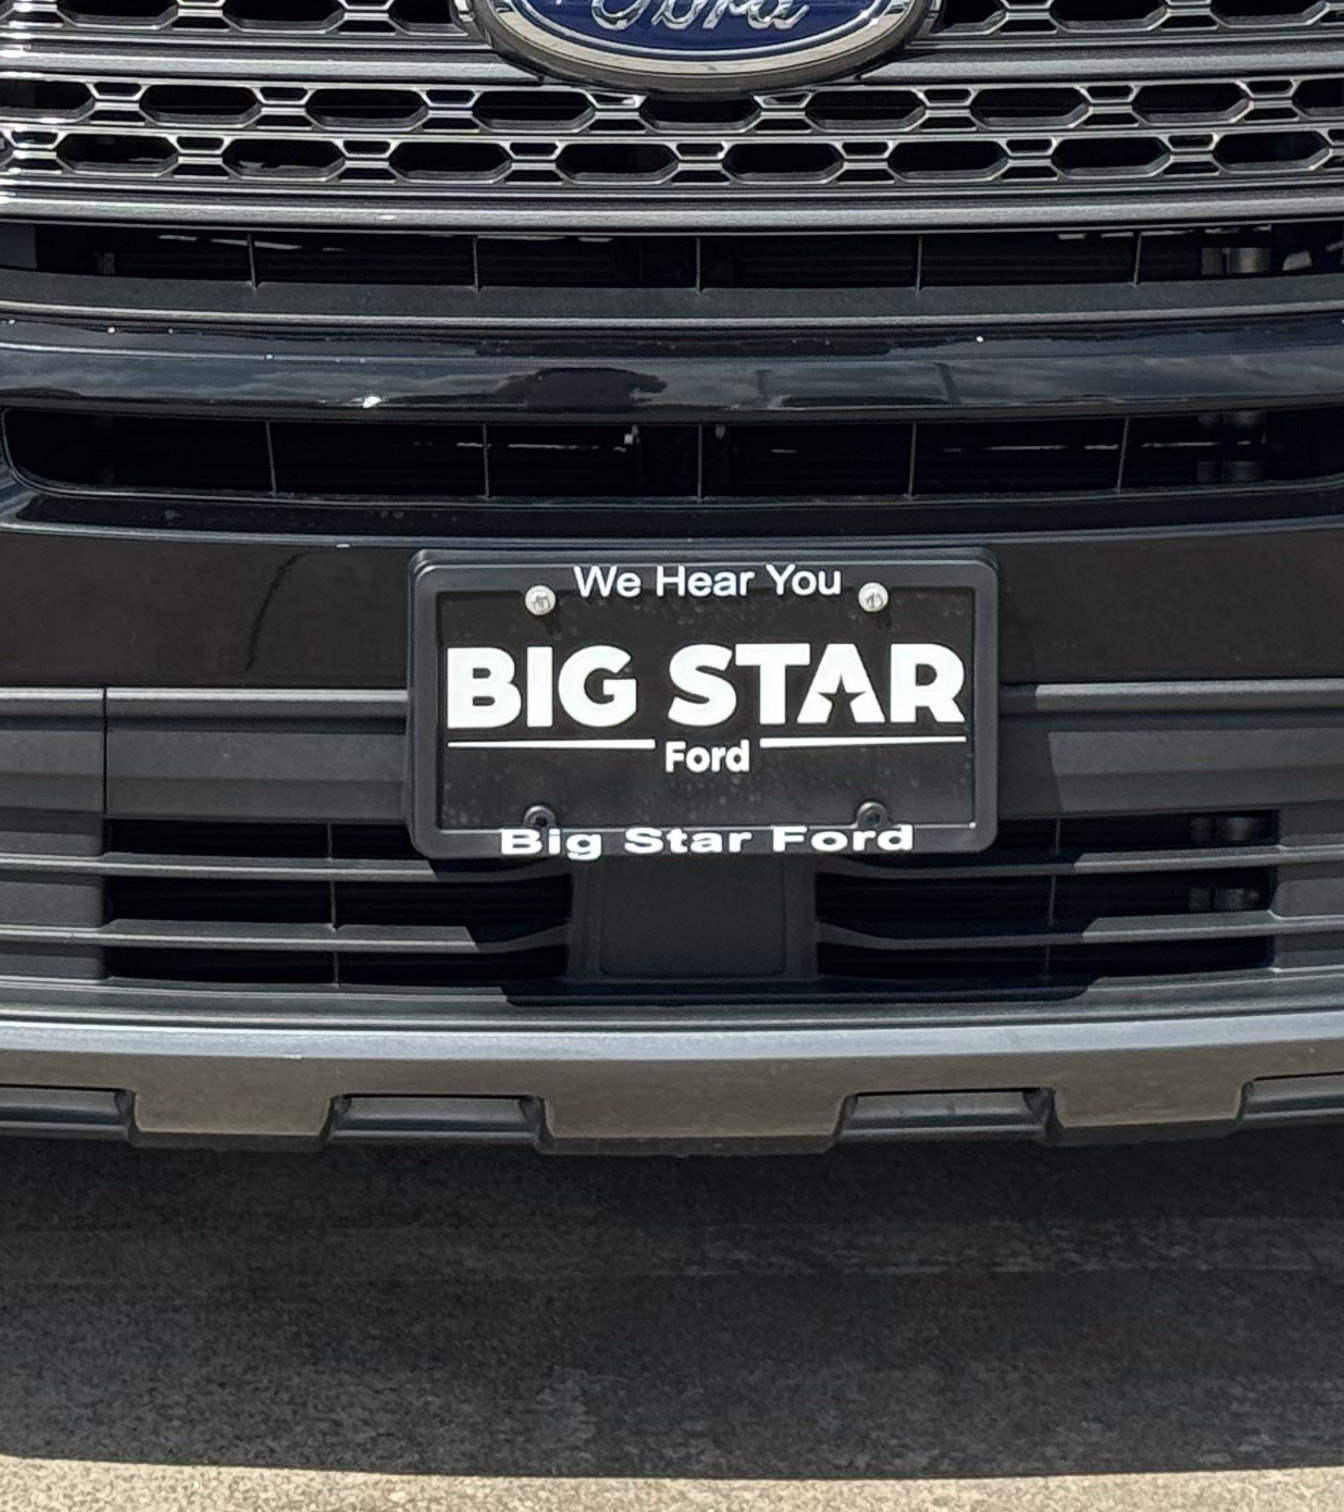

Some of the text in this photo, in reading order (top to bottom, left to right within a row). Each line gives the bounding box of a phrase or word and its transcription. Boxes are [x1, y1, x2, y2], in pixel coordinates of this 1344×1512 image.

[573, 563, 842, 598] We Hear You
[447, 643, 966, 729] BIG STAR
[665, 739, 751, 773] Ford
[499, 824, 914, 861] Big Star Ford
